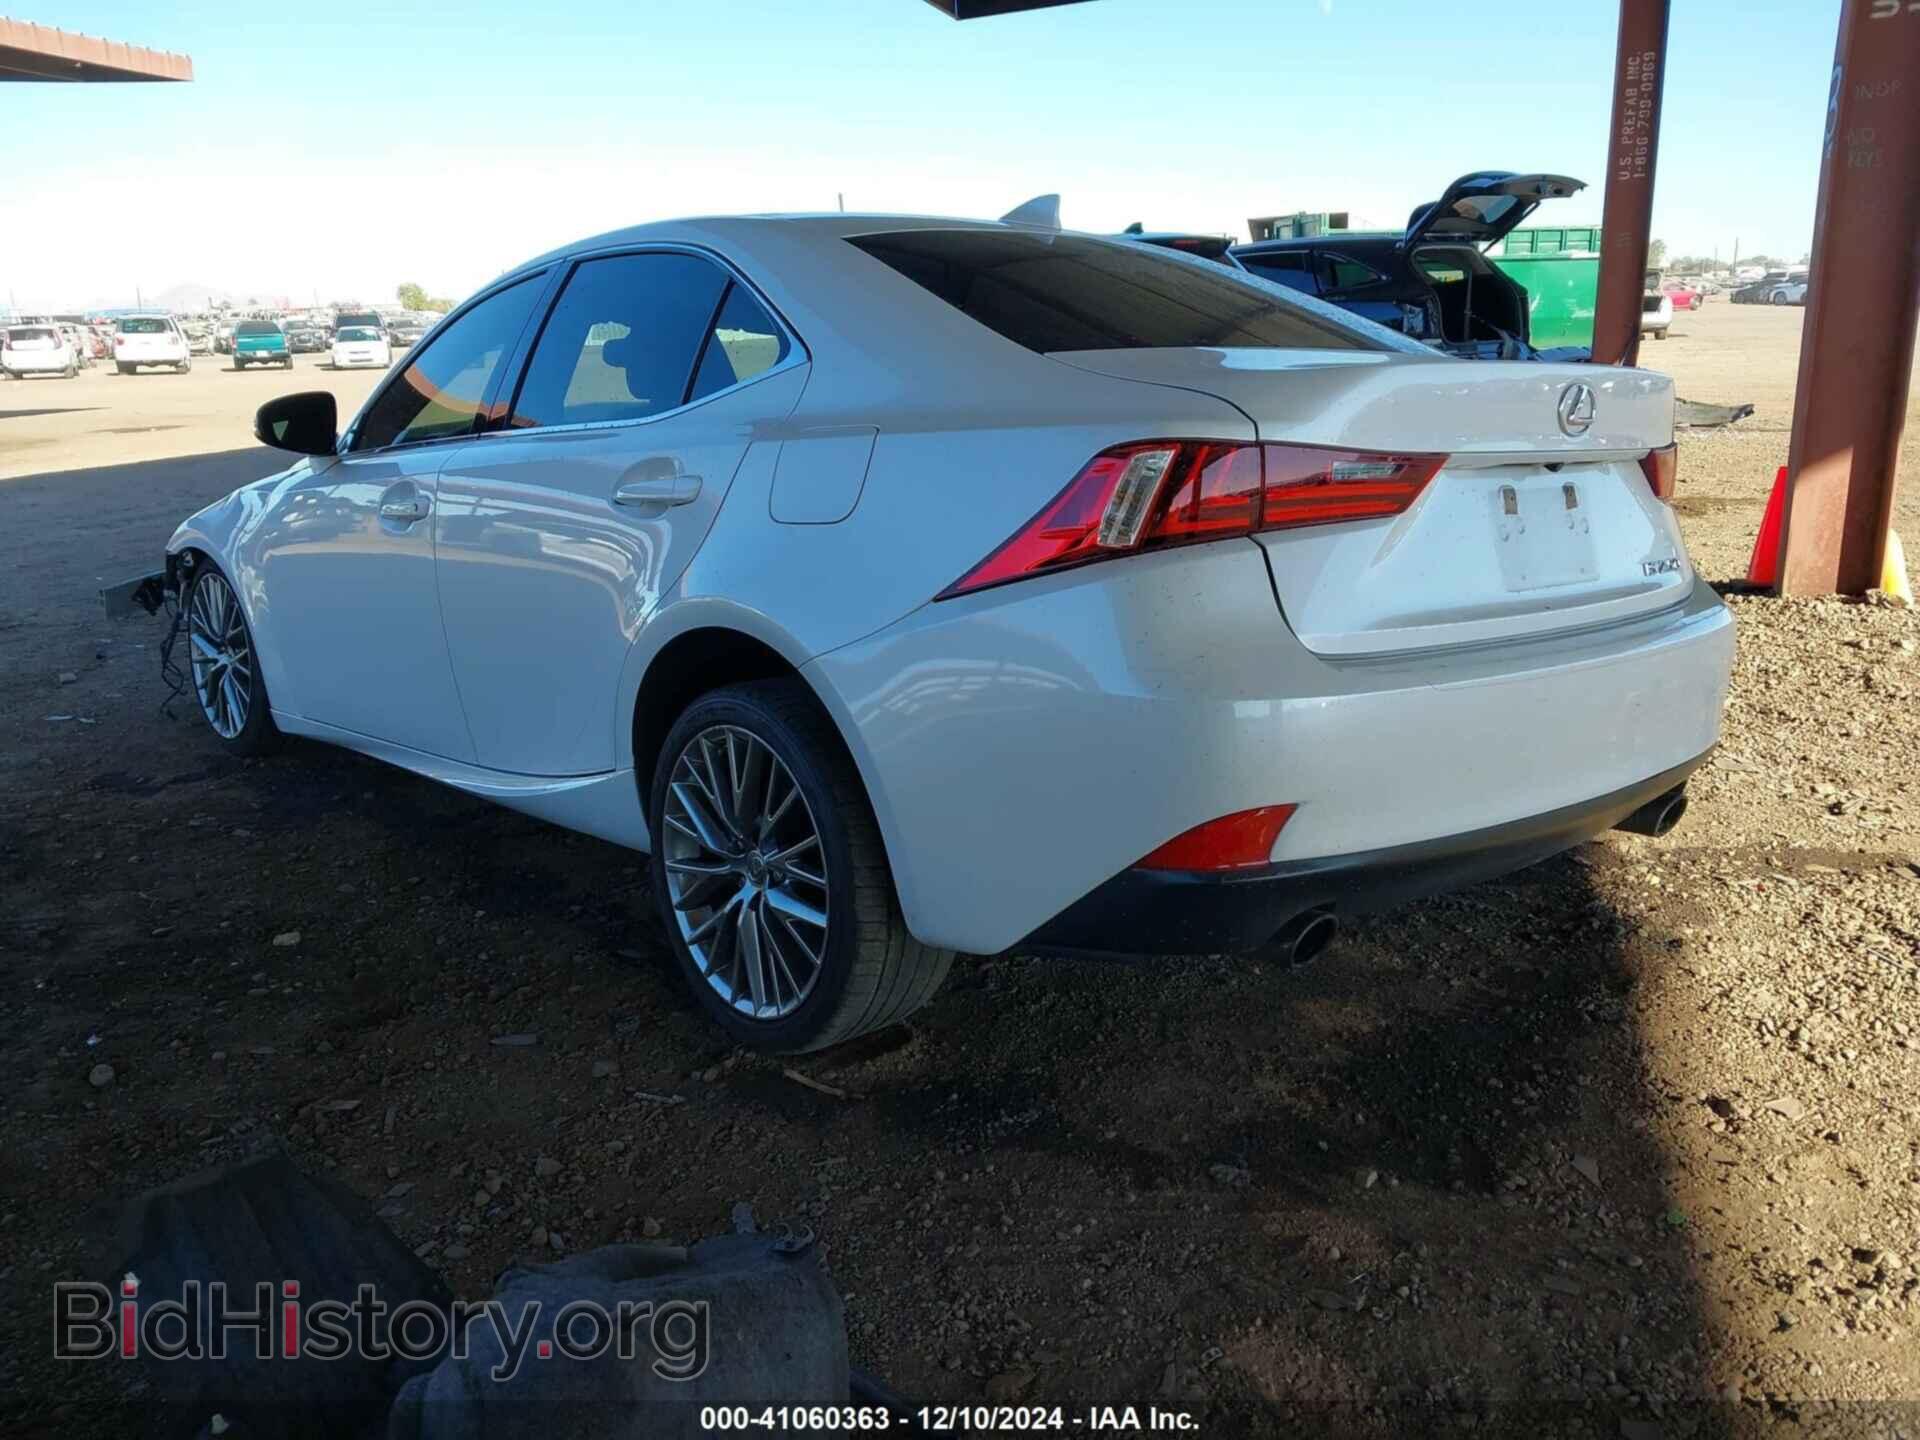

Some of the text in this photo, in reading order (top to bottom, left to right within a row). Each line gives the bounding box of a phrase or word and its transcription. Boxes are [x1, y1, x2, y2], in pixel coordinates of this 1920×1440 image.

[1619, 52, 1642, 180] U.S. PREFAB INC.
